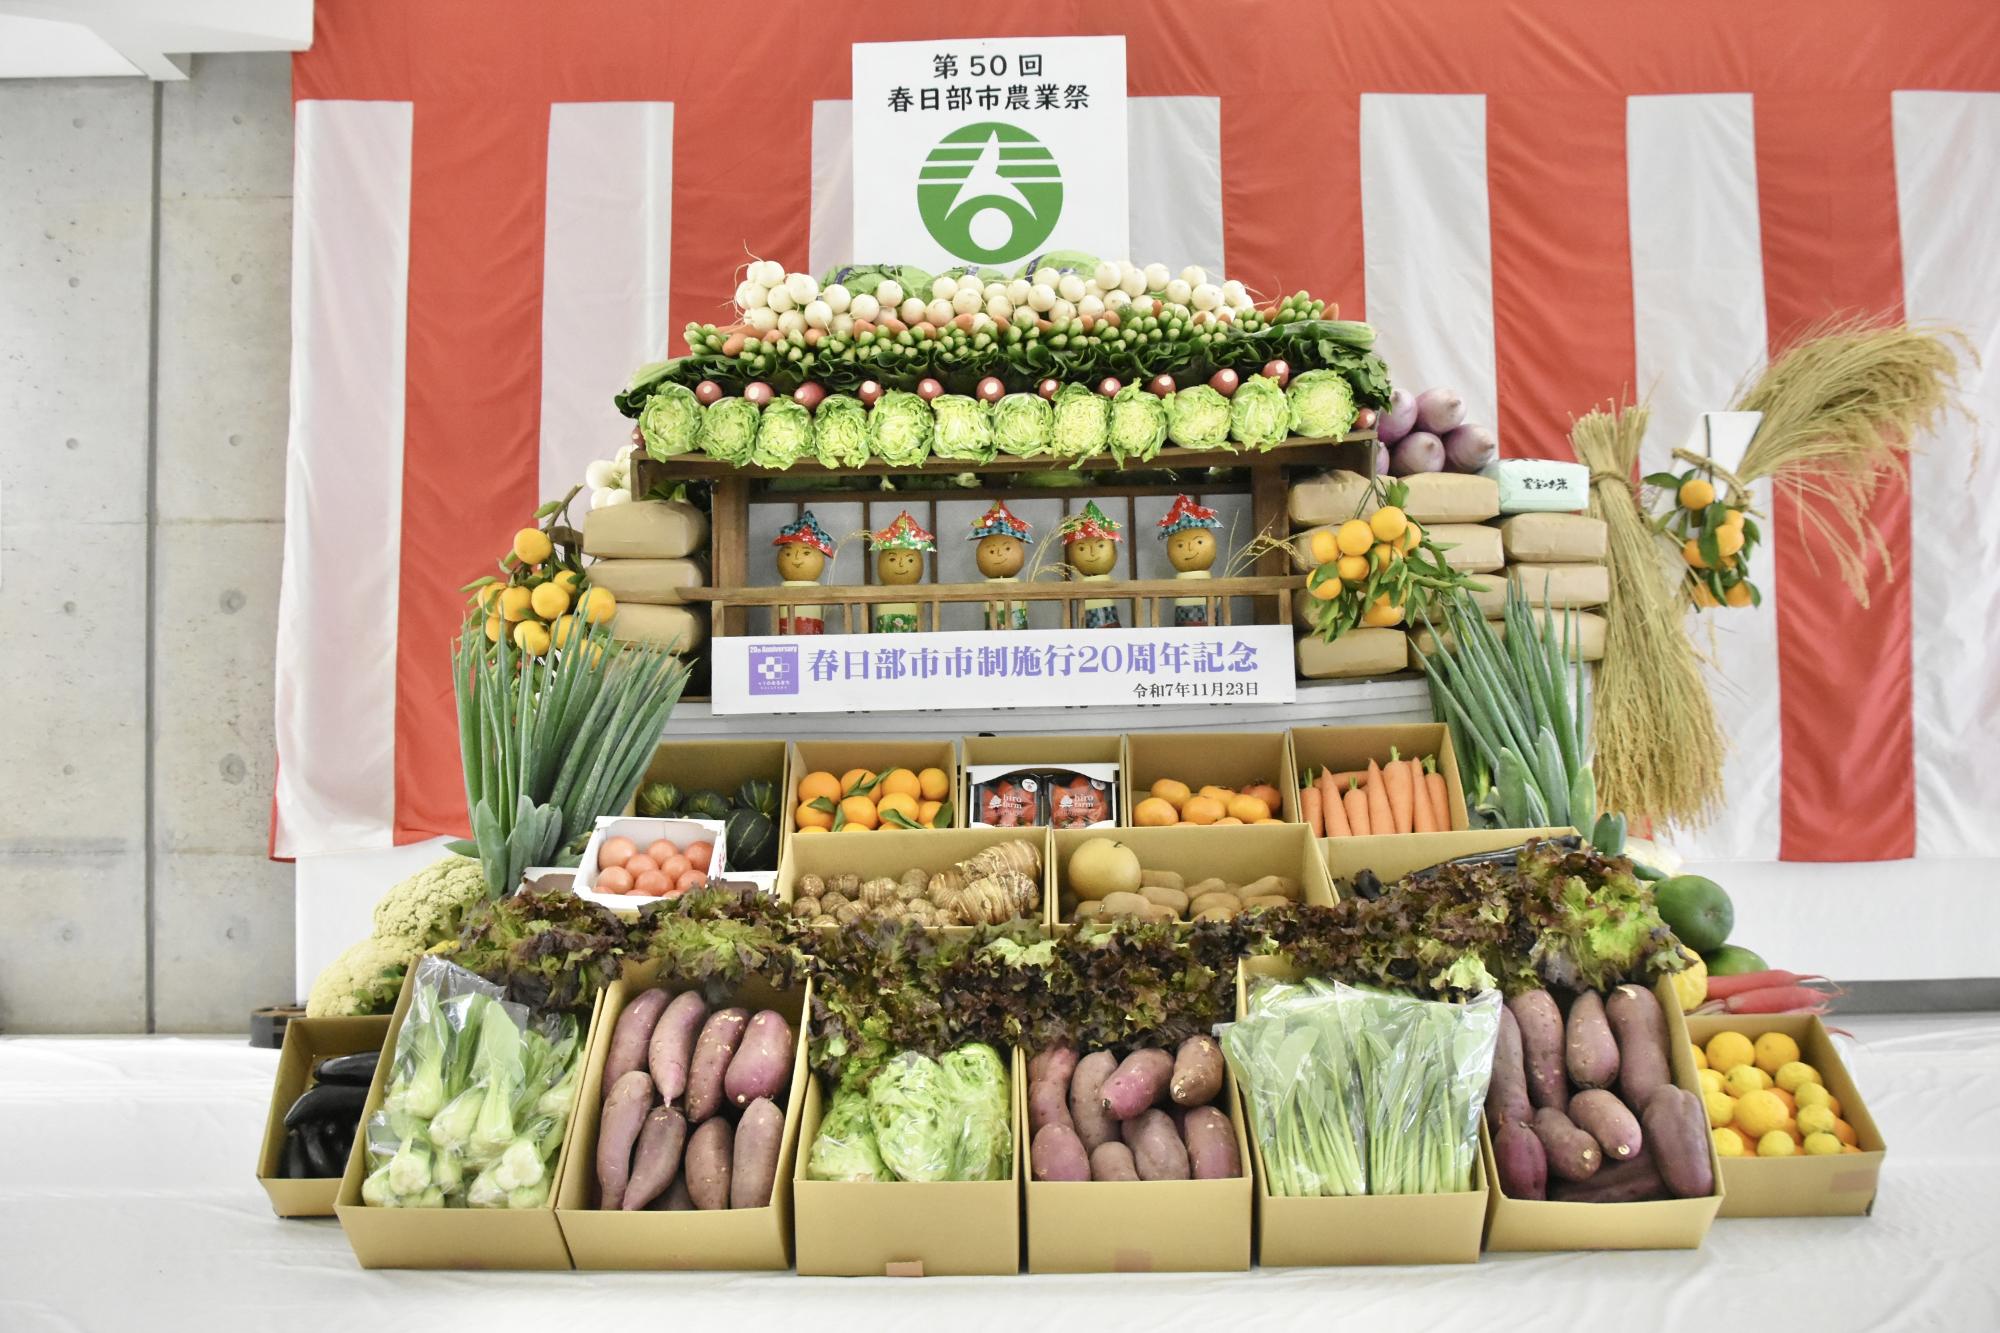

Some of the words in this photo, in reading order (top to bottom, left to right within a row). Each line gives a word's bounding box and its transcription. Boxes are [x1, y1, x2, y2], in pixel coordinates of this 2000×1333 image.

[932, 53, 1043, 80] 第50回
[887, 83, 1090, 113] 春日部市農業祭
[808, 641, 1258, 682] 春日部市市制施行20周年記念
[1133, 682, 1258, 698] 令和7年11月23日
[1003, 794, 1022, 802] hiro
[1003, 801, 1022, 809] farm
